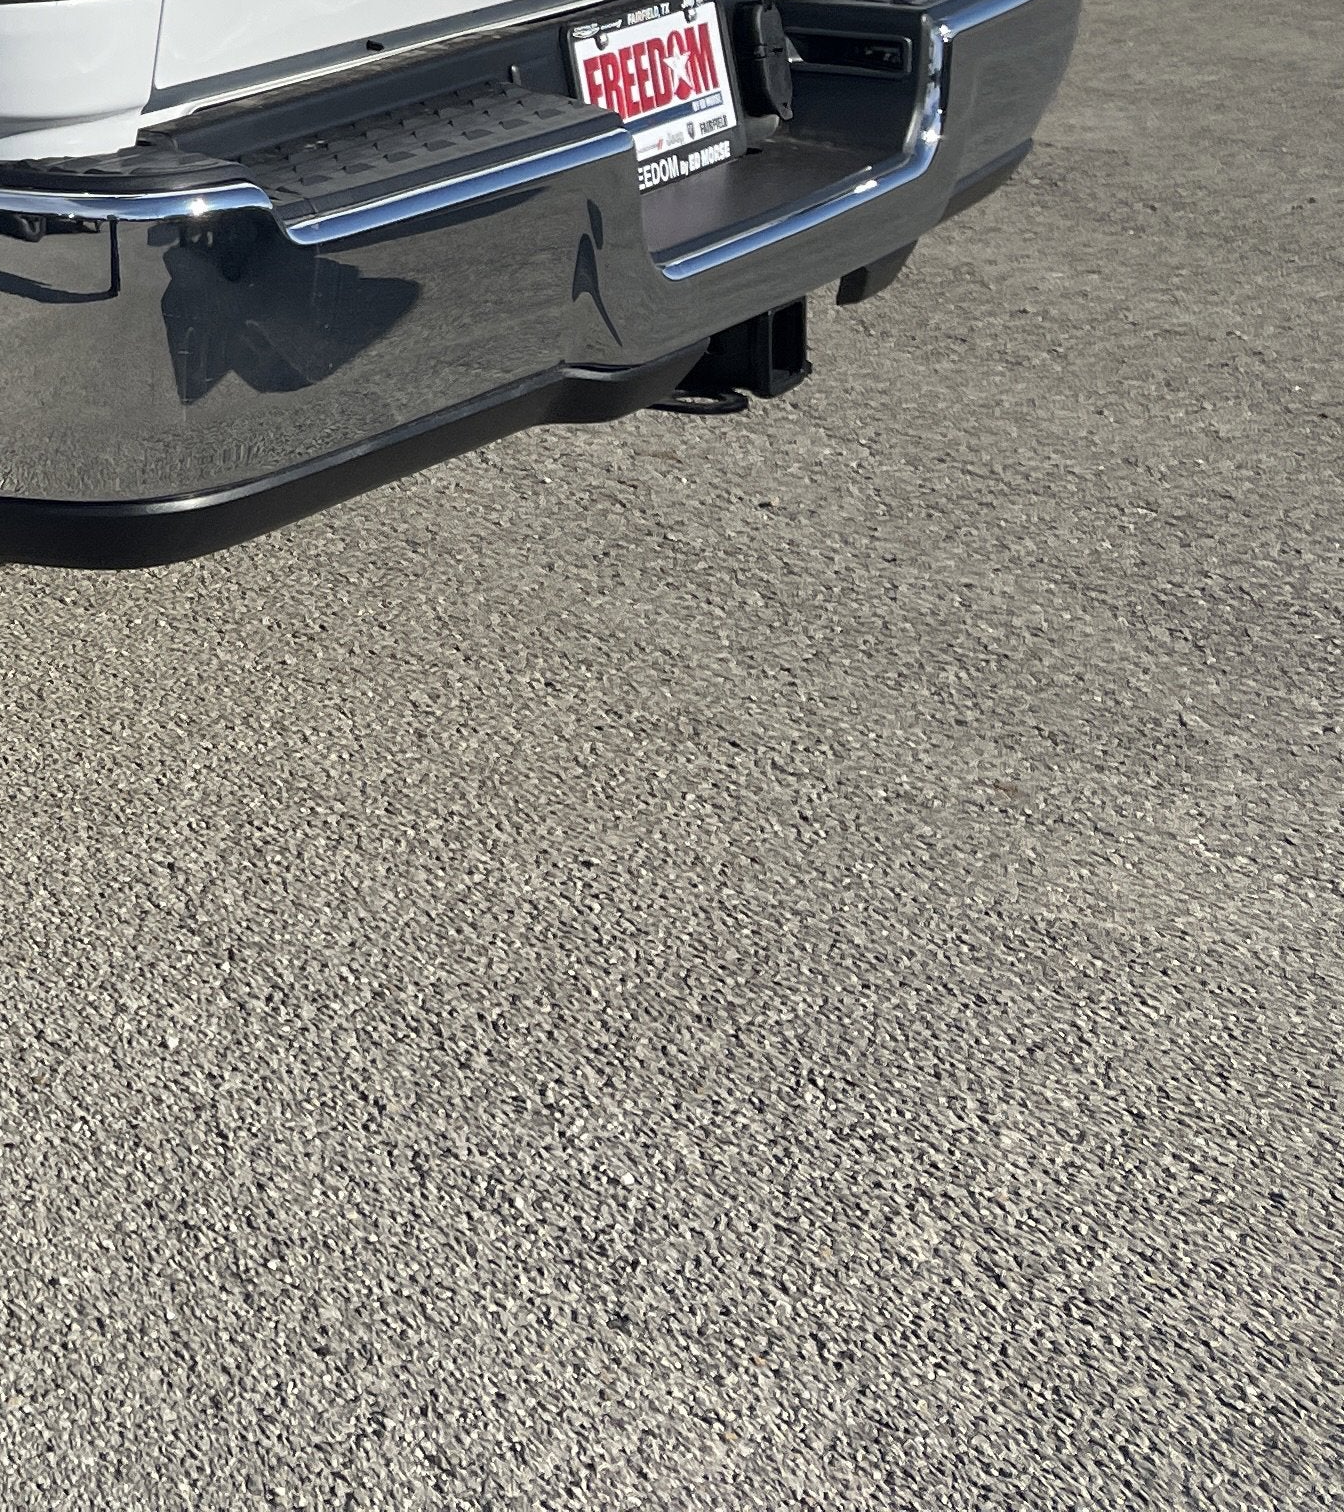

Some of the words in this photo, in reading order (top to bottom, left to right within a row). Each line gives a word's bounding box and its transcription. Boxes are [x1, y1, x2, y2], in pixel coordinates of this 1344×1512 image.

[583, 22, 720, 120] FREEDOM
[688, 151, 701, 172] ED
[700, 140, 731, 167] MORSE
